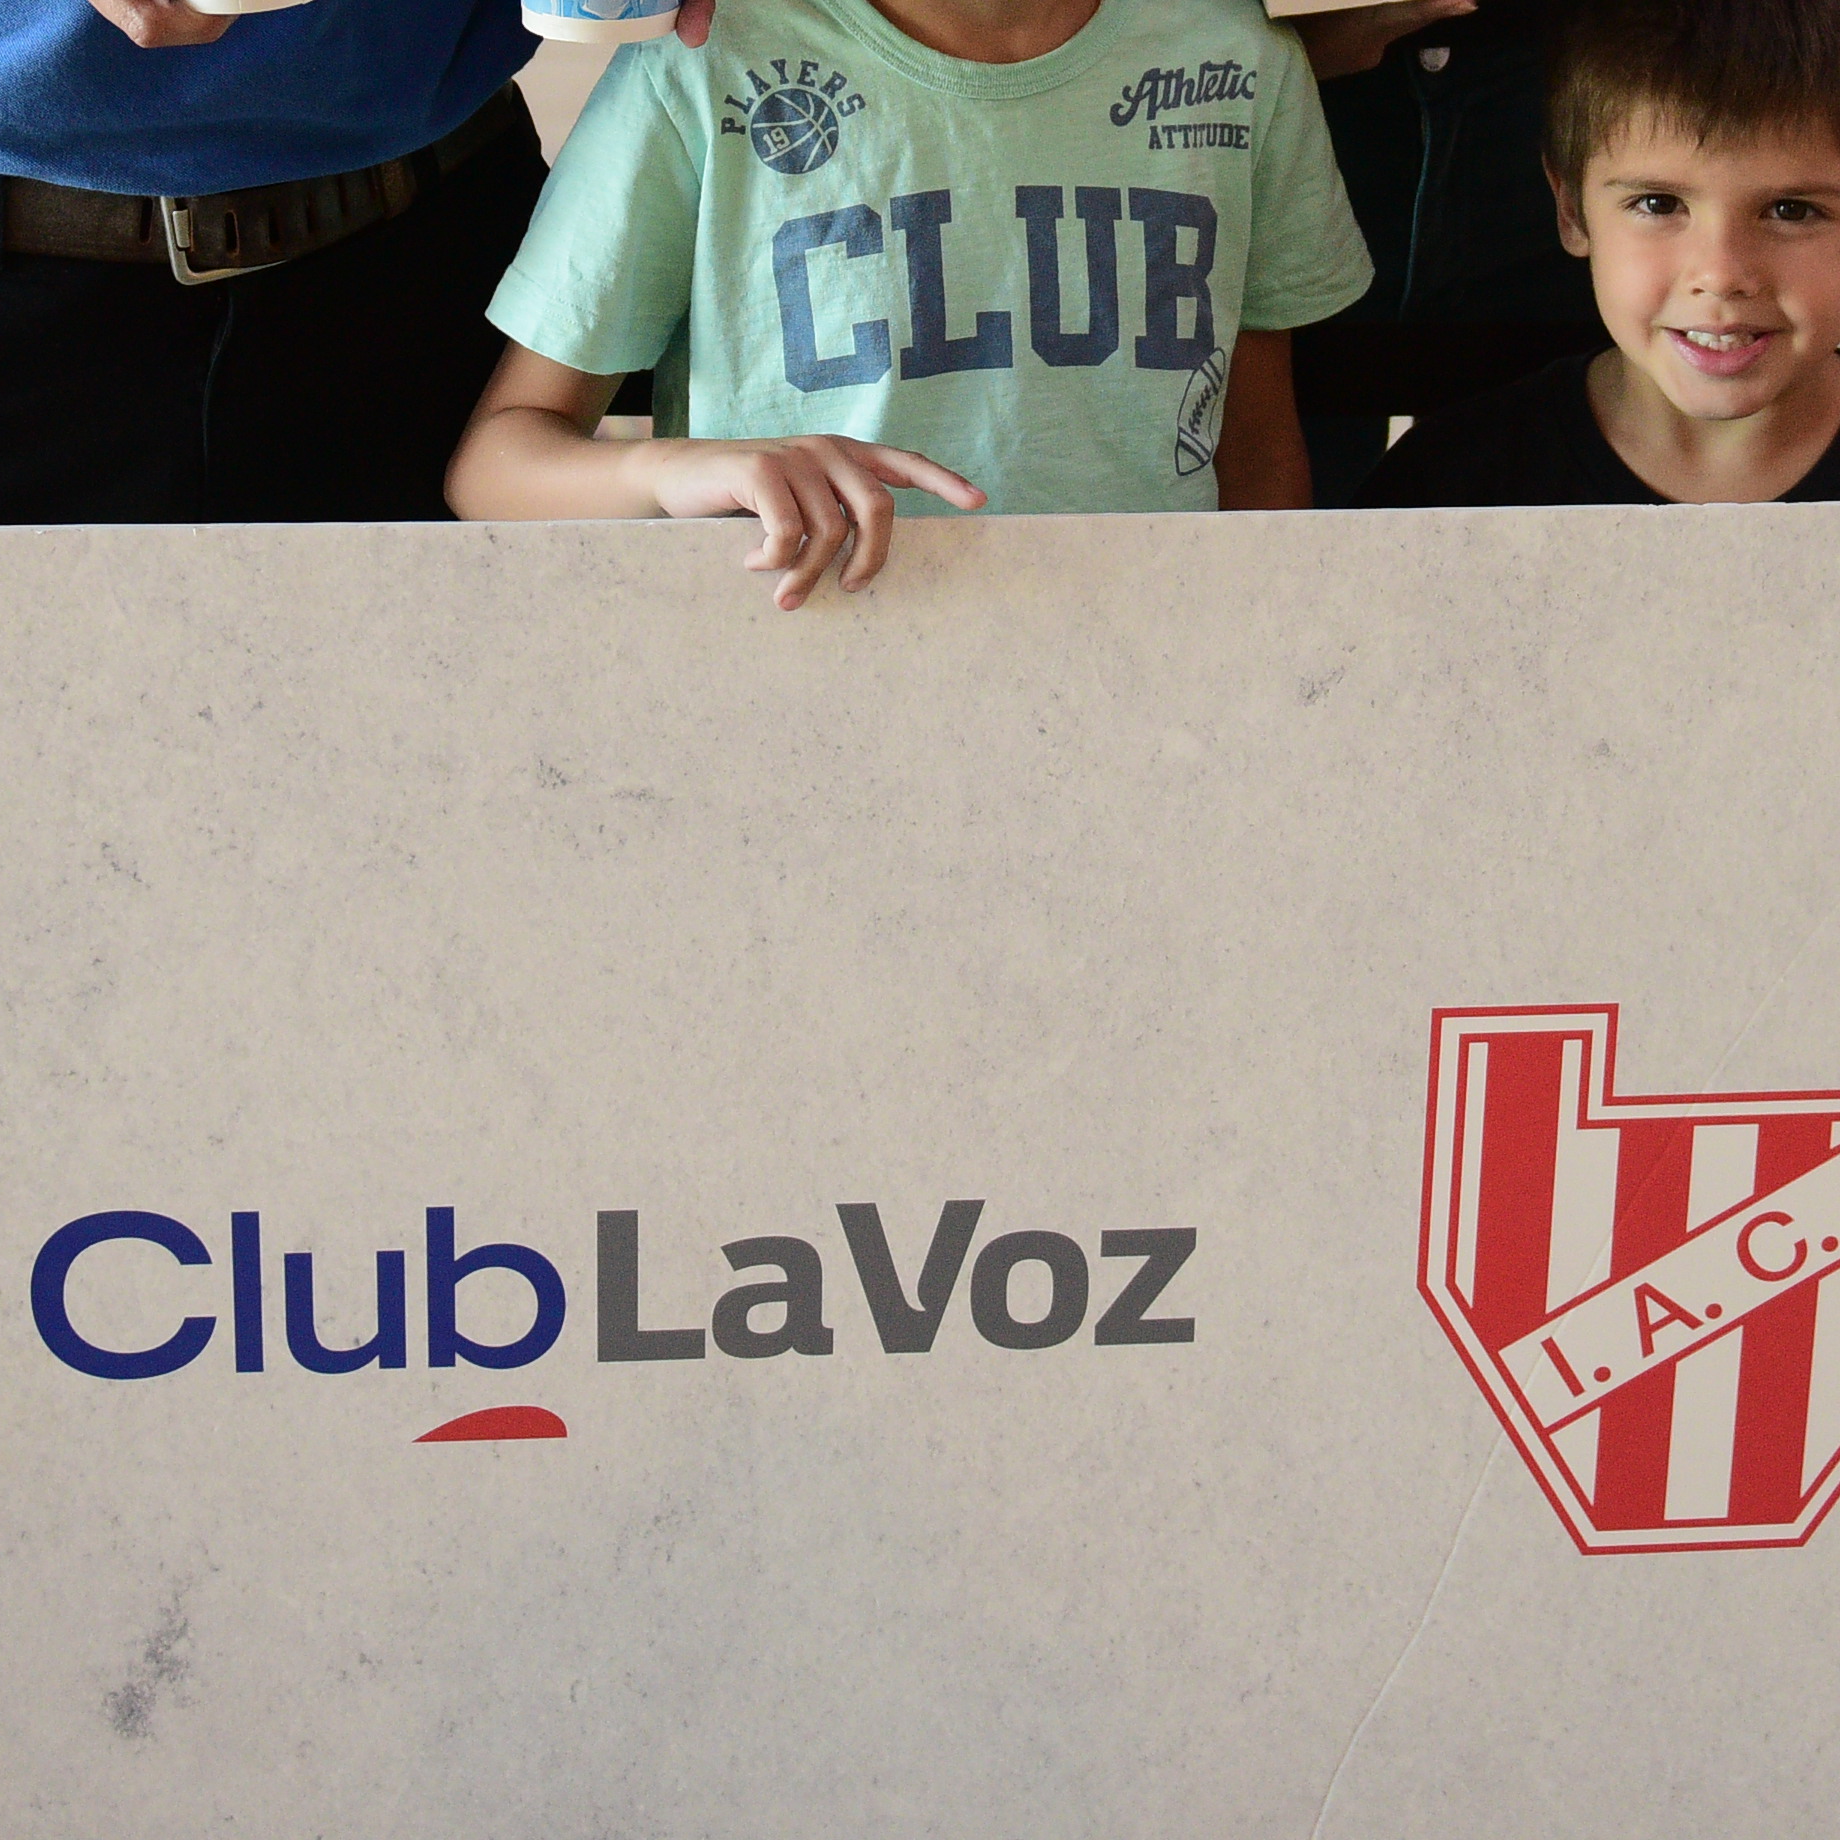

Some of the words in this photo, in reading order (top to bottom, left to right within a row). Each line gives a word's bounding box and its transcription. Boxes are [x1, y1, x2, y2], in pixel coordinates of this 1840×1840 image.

[720, 57, 867, 137] PLAYERS
[1109, 59, 1256, 127] Athletic
[761, 126, 790, 153] 19
[1148, 122, 1250, 151] ATTITUDE
[771, 184, 1219, 394] CLUB
[30, 1205, 567, 1381] Club
[596, 1197, 1198, 1363] LaVoz
